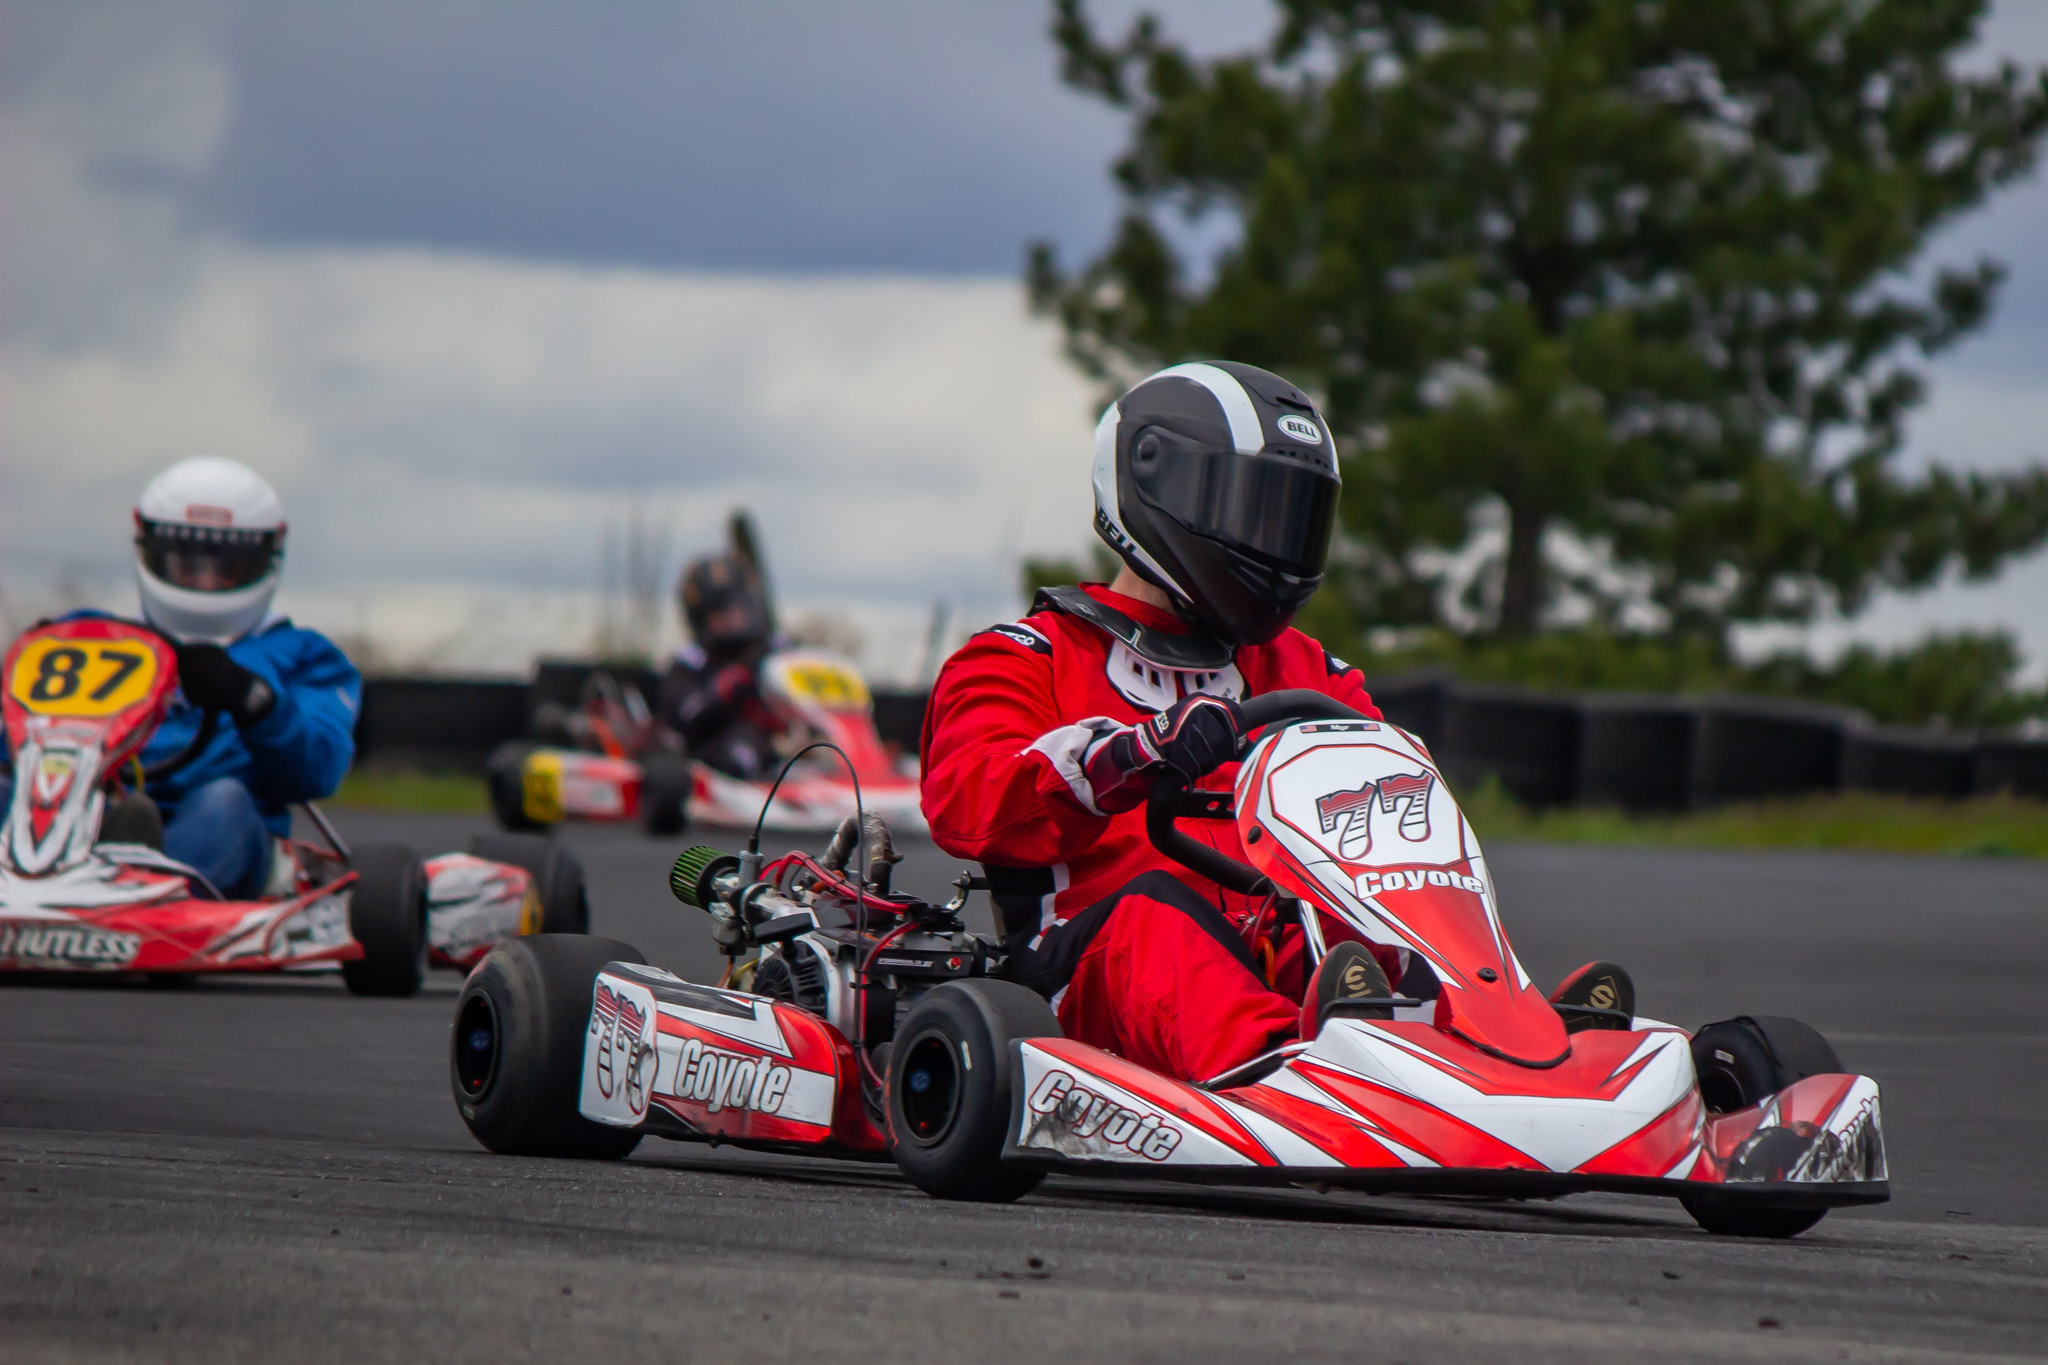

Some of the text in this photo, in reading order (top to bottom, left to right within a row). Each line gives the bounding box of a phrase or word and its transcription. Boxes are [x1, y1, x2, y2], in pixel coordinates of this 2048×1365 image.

[1287, 421, 1317, 438] BELL
[1097, 505, 1137, 553] BELL
[30, 648, 144, 701] 87
[1315, 769, 1436, 861] 77
[1355, 869, 1486, 901] Coyote
[591, 978, 647, 1116] 77
[673, 1037, 792, 1114] Coyote
[1027, 1069, 1183, 1162] Coyote
